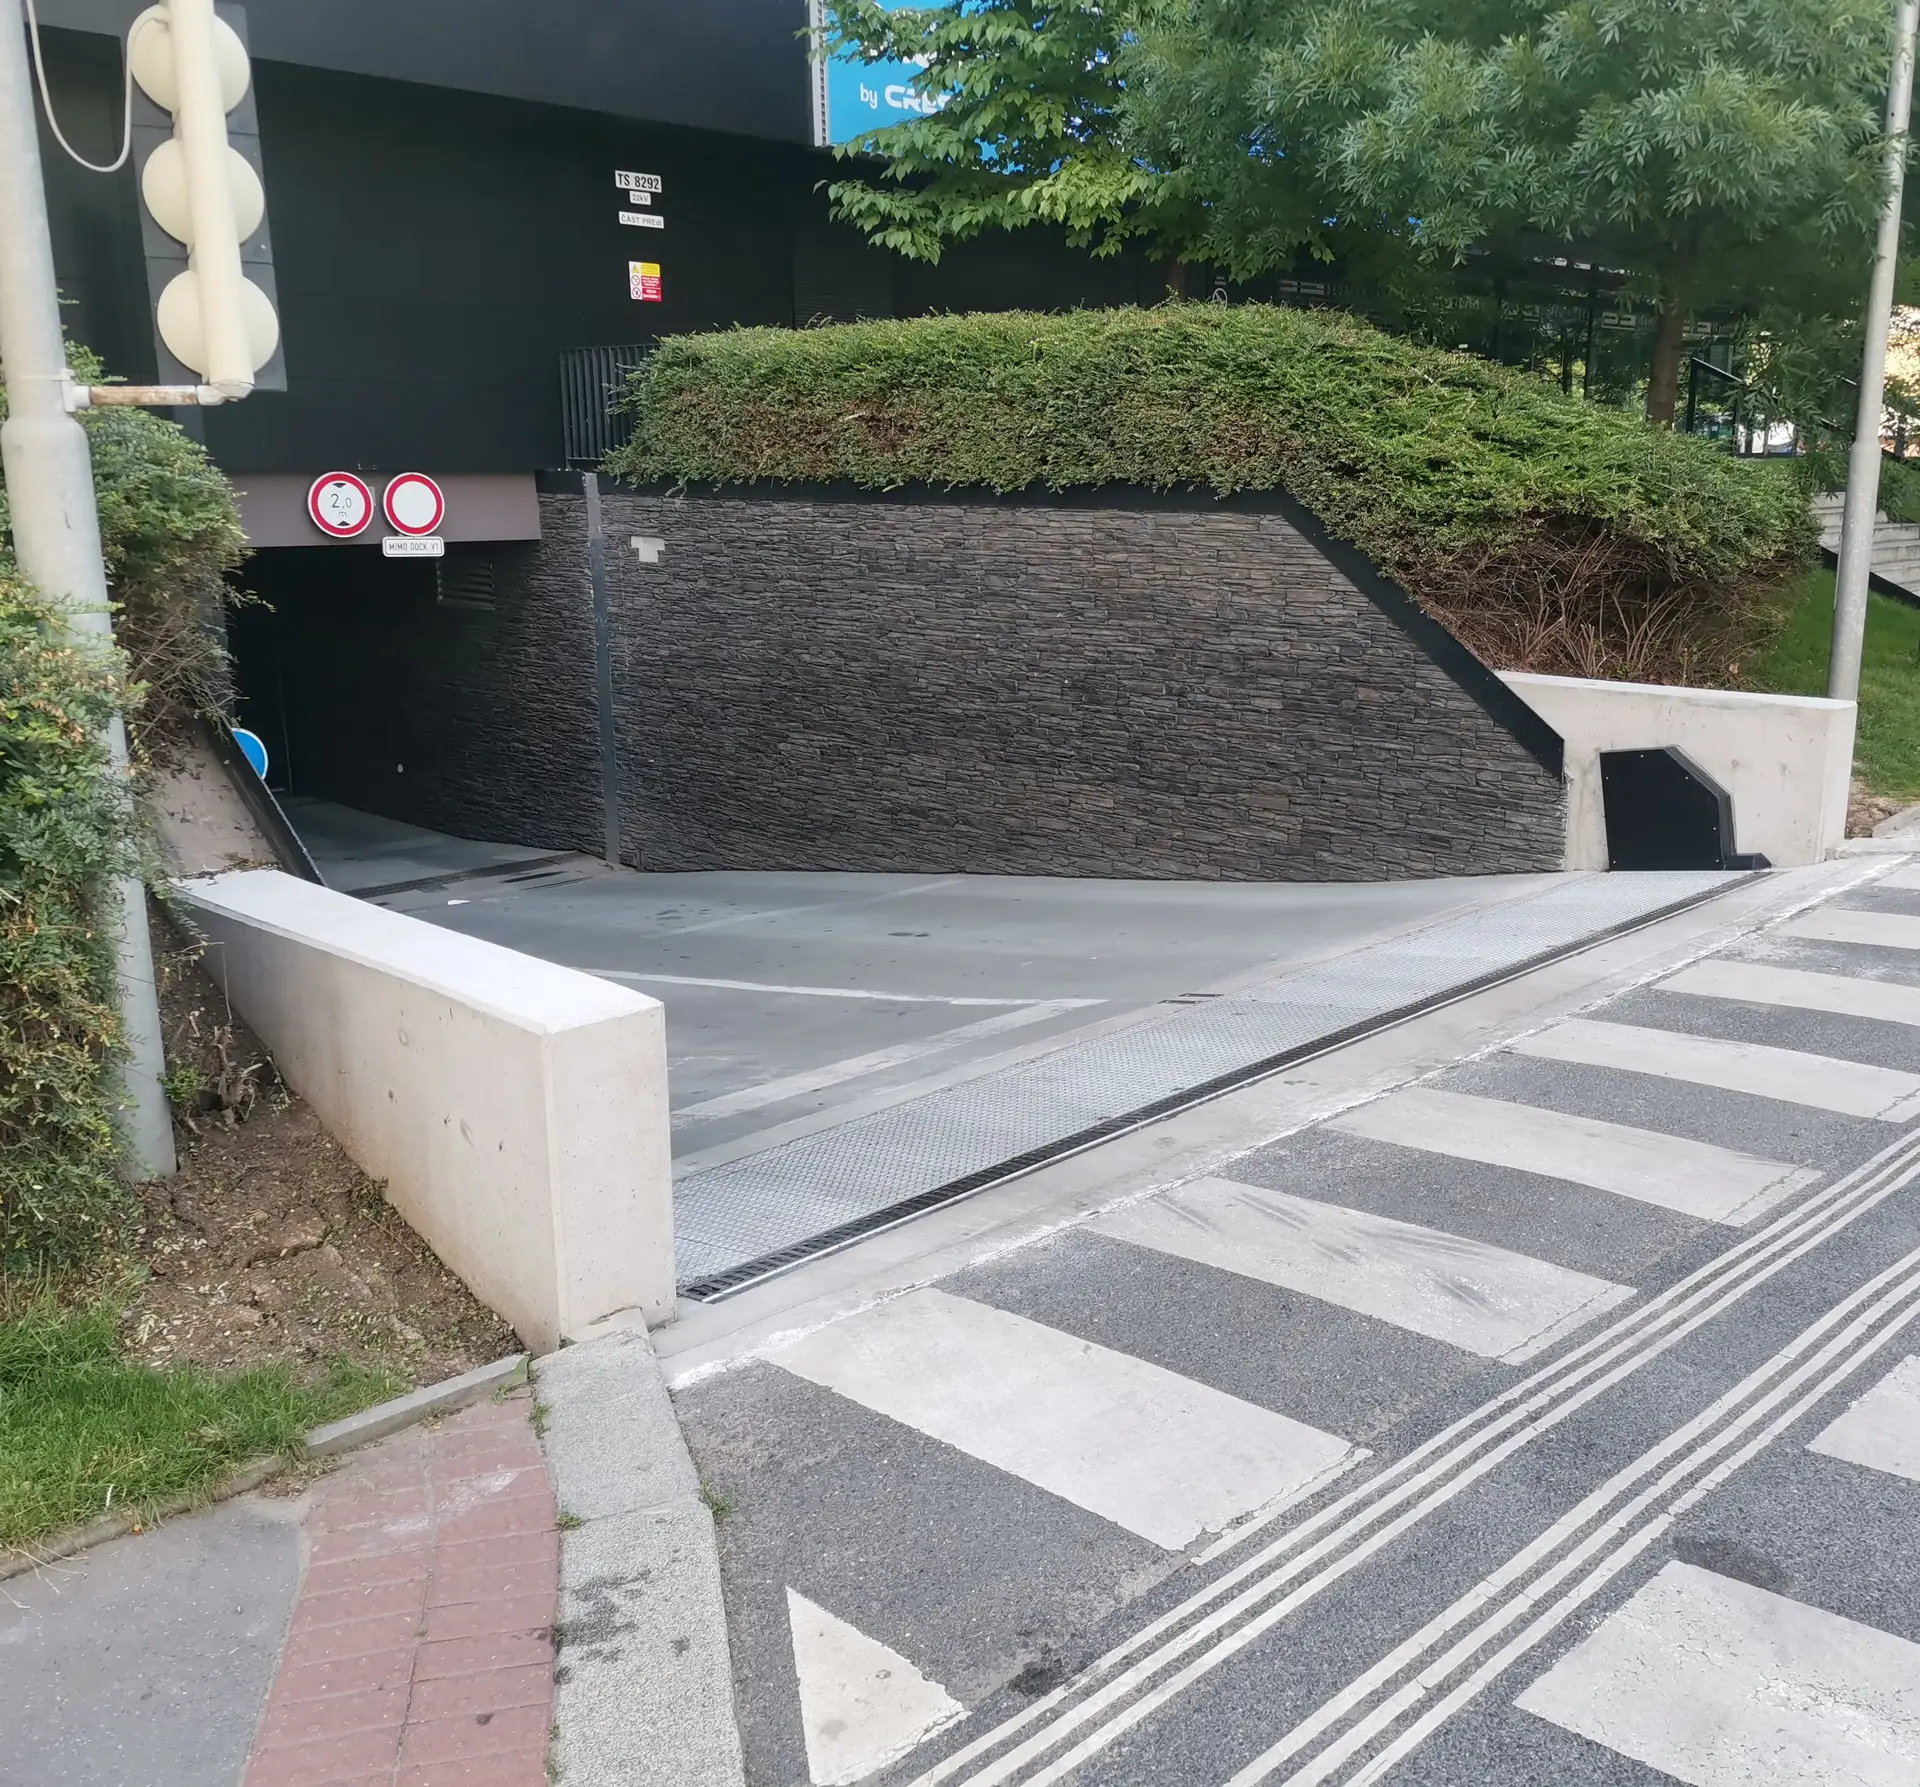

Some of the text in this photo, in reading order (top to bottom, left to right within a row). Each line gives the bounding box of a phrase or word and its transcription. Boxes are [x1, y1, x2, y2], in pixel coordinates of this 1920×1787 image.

[860, 82, 878, 110] by
[617, 173, 659, 190] TS 8292
[330, 493, 352, 508] 2.0
[388, 542, 439, 551] MIMO DOCK V1
